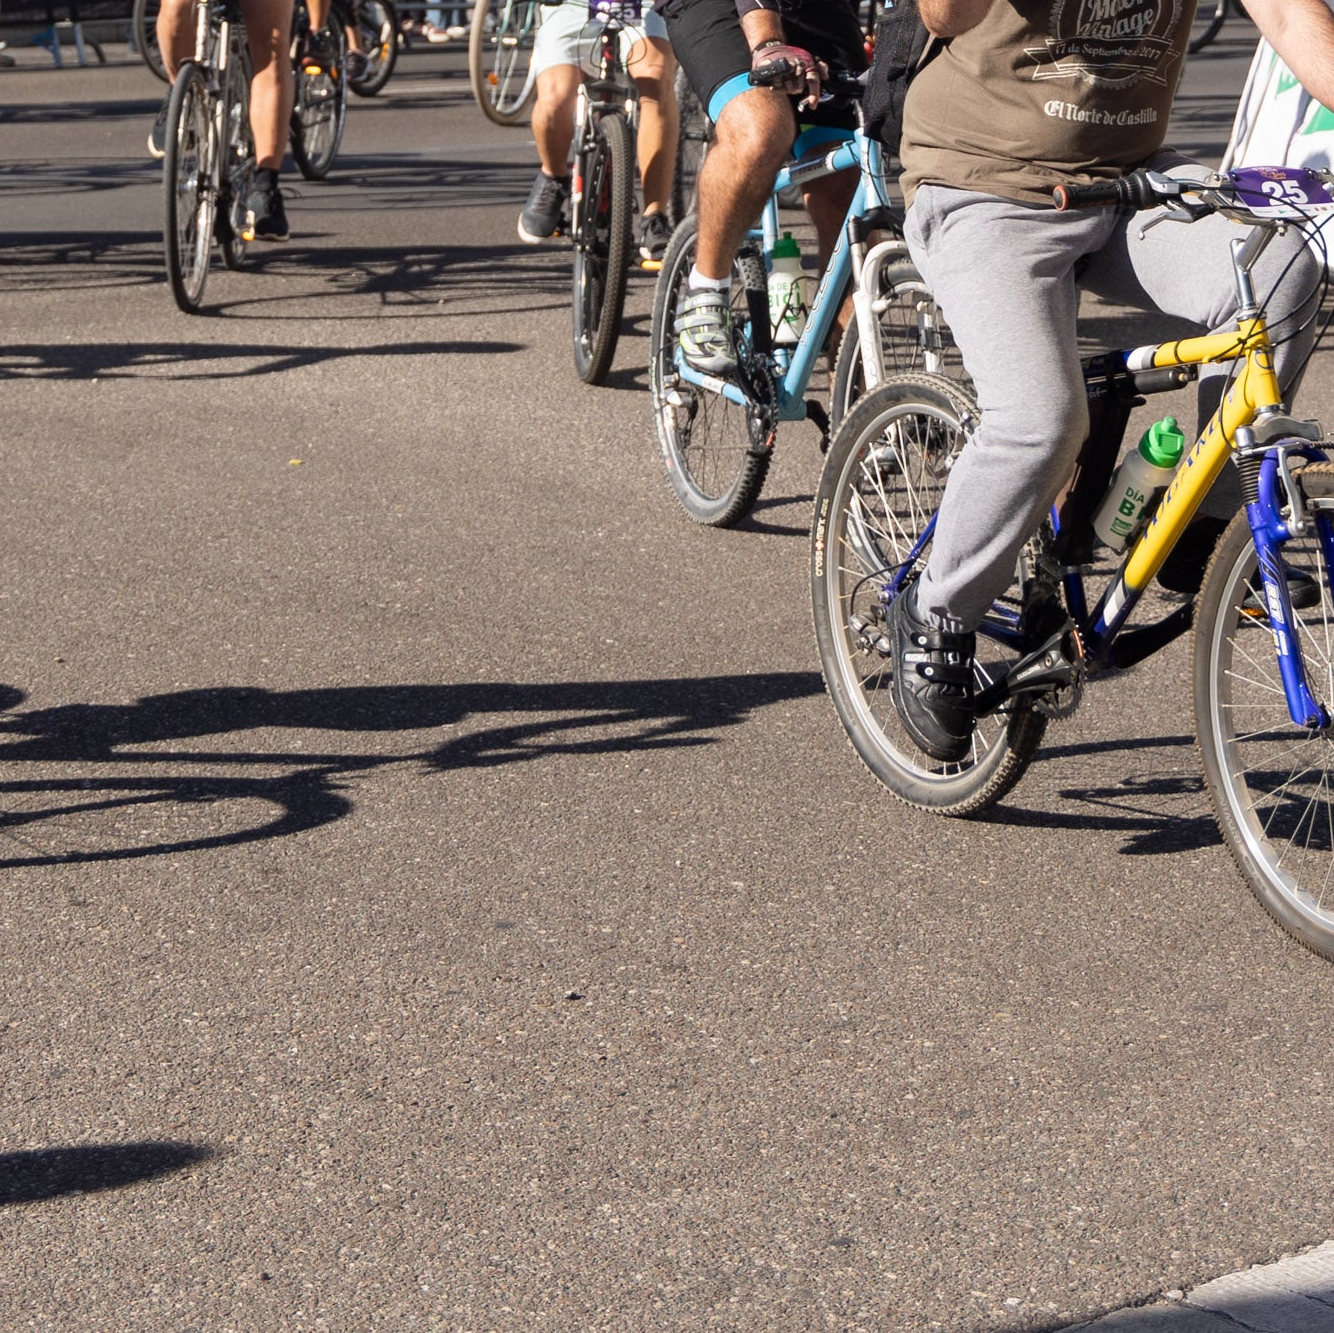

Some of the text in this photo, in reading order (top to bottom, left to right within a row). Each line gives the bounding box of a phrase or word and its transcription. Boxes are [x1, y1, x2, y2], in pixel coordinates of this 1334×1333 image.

[1044, 100, 1157, 126] El Norte de Castilla
[1261, 180, 1308, 207] 25
[1125, 486, 1145, 504] DÍA
